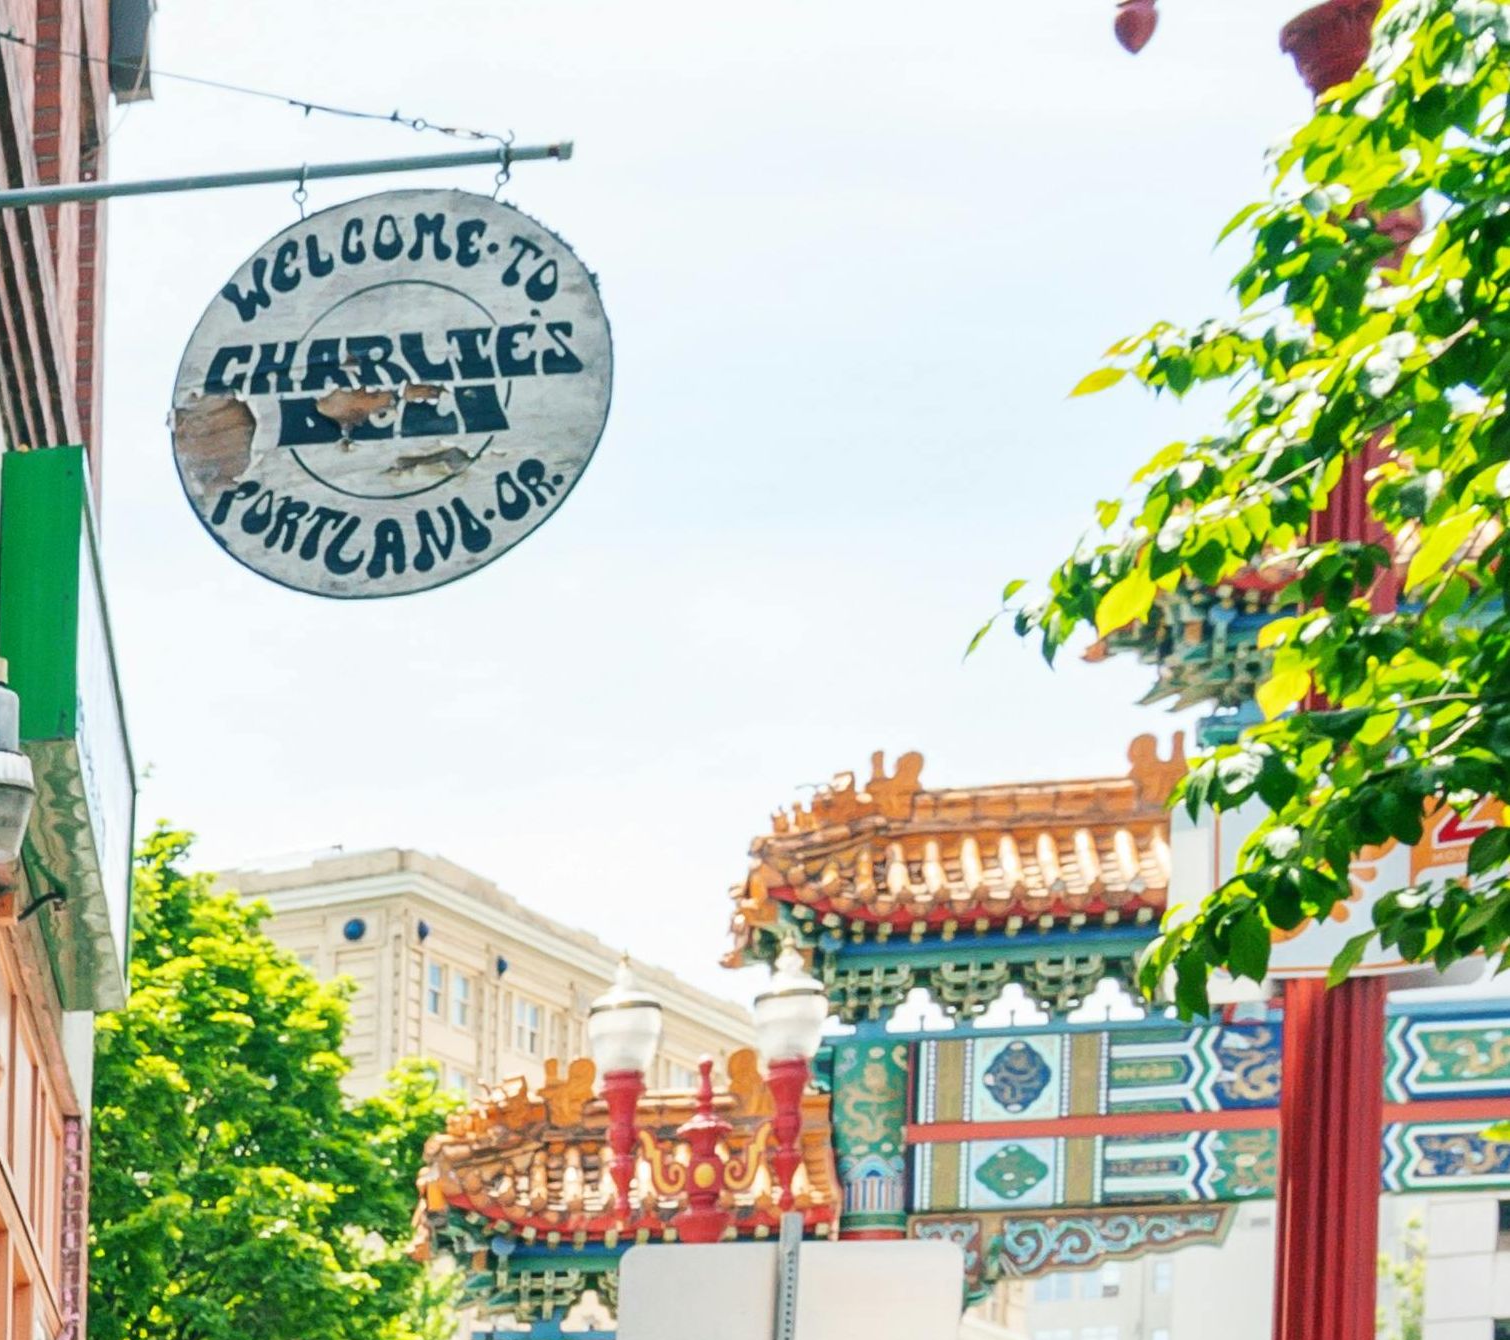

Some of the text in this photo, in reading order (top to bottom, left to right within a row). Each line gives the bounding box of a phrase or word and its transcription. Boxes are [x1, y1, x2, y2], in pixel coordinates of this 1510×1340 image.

[221, 213, 558, 322] WELCOME TO
[211, 480, 492, 579] PORTLAND
